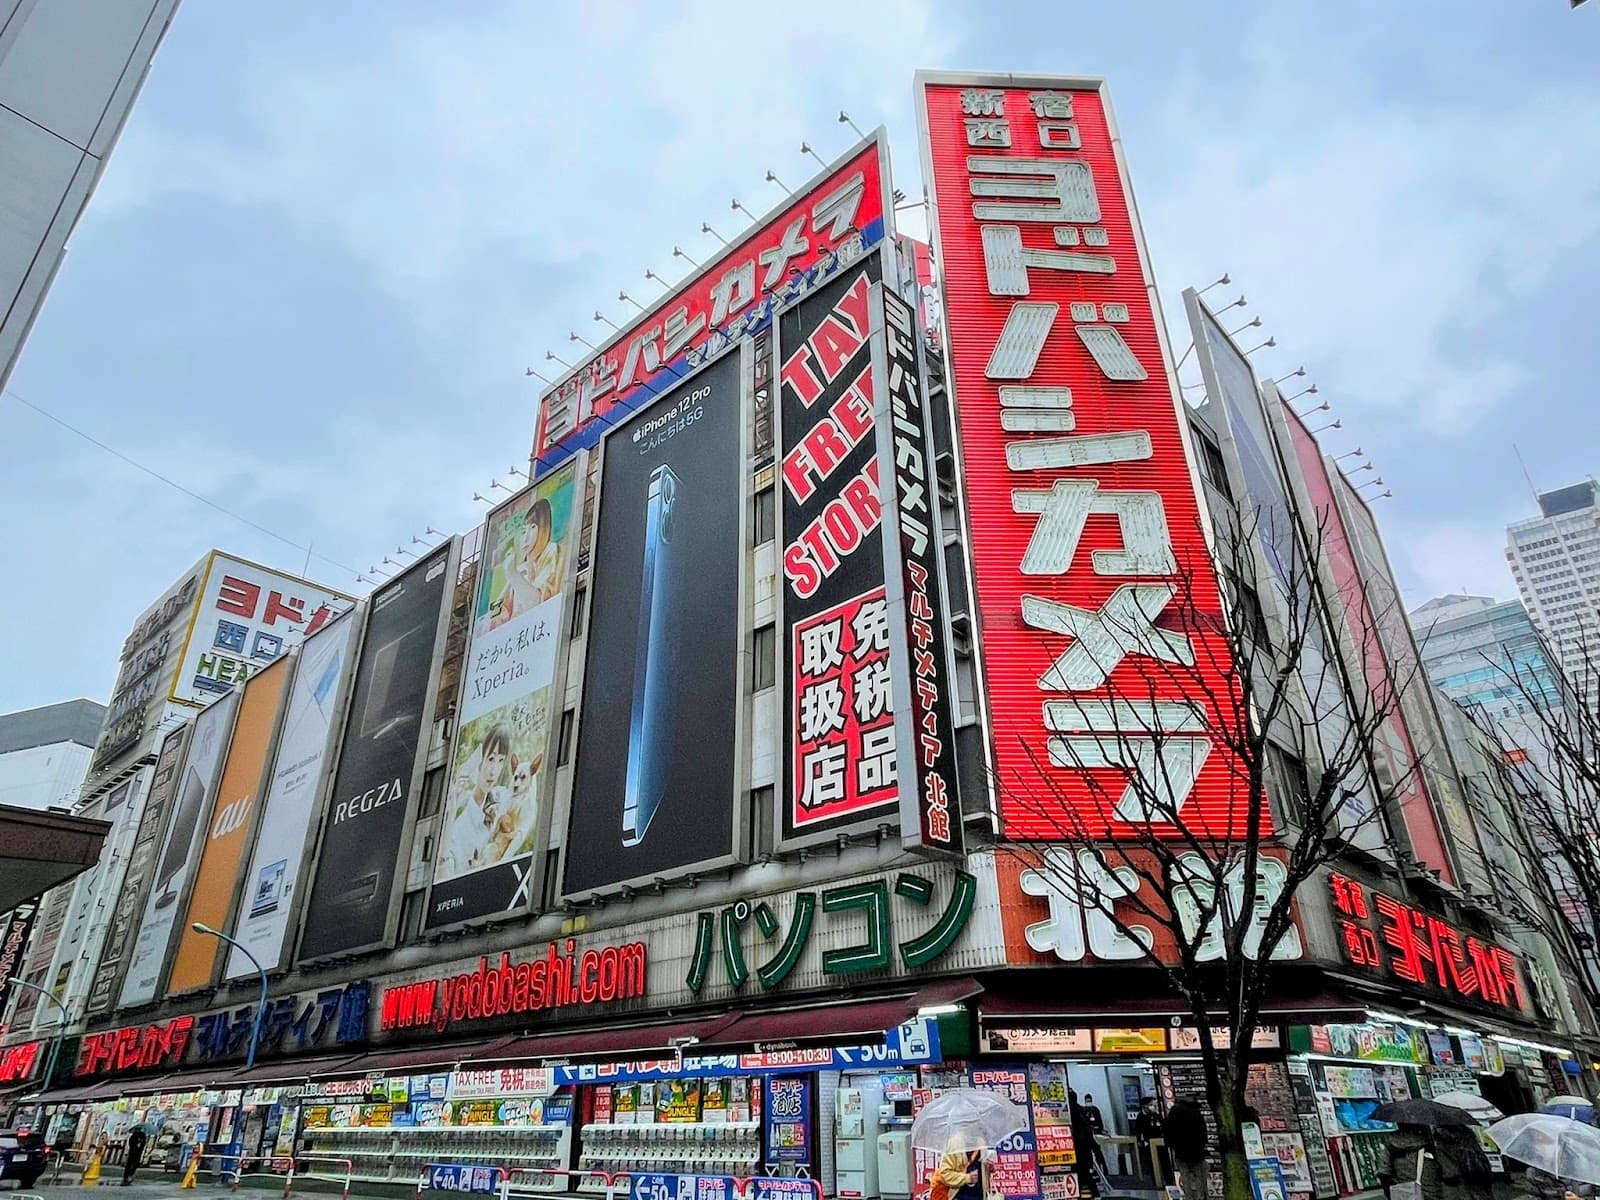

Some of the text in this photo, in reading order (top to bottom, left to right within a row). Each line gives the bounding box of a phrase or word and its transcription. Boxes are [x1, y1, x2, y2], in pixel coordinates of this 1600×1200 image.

[960, 88, 1073, 119] 新宿
[964, 118, 1082, 149] 西口
[543, 172, 865, 448] ヨドバシカメラ
[641, 385, 711, 438] iPhone 12 Pro
[884, 290, 930, 556] ヨドバシカメラ
[967, 155, 1213, 822] ヨドバシカメラ
[784, 455, 881, 600] STOR
[213, 619, 283, 661] 西口
[196, 651, 252, 684] HEA
[800, 618, 847, 808] 取扱店
[212, 795, 251, 840] au
[334, 778, 402, 825] REGZA
[436, 896, 464, 913] XPERIA
[686, 868, 977, 996] パソコン
[381, 937, 648, 1033] www.yodobashi.com
[454, 1072, 471, 1086] TAX
[473, 1070, 495, 1085] FREE
[500, 1068, 525, 1091] 免税
